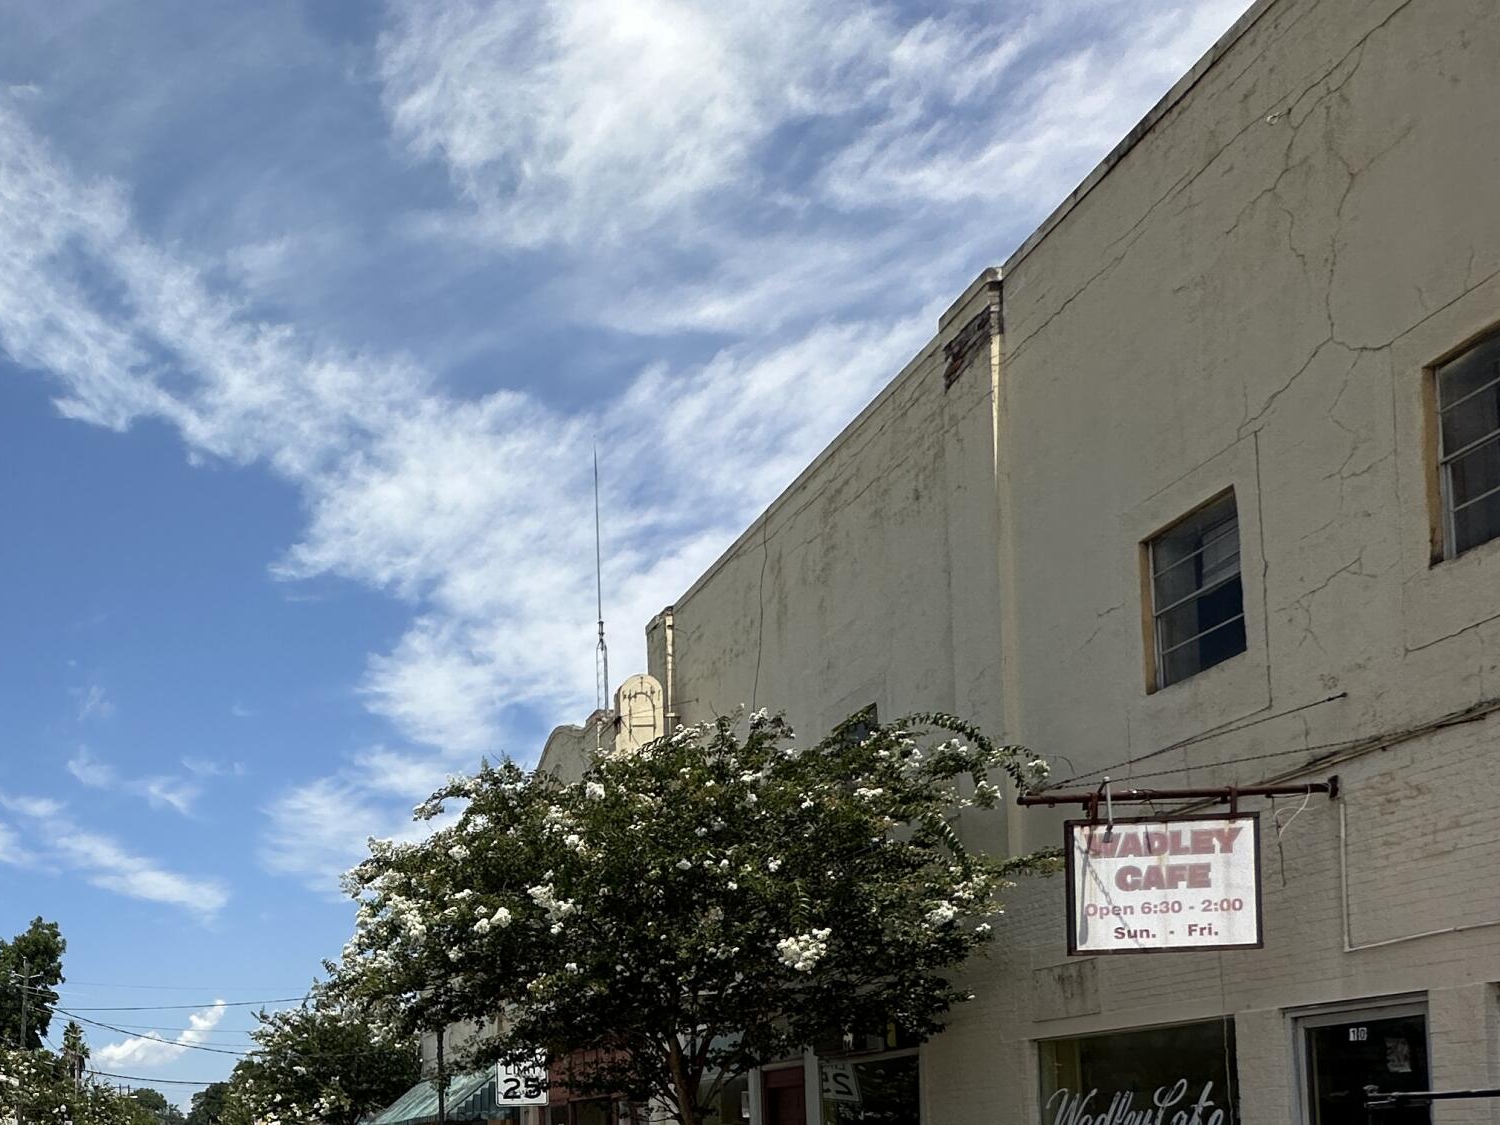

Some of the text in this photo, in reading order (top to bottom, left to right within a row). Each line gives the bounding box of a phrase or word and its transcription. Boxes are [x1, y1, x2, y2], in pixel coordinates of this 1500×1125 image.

[1085, 826, 1243, 859] WADLEY
[1114, 862, 1212, 892] CAFE
[1084, 902, 1135, 919] Open
[1140, 899, 1183, 915] 6:30
[1201, 897, 1244, 913] 2:00
[1113, 926, 1157, 940] Sun.
[1187, 923, 1219, 938] Fri.
[1351, 1028, 1366, 1040] 10
[503, 1078, 542, 1099] 25
